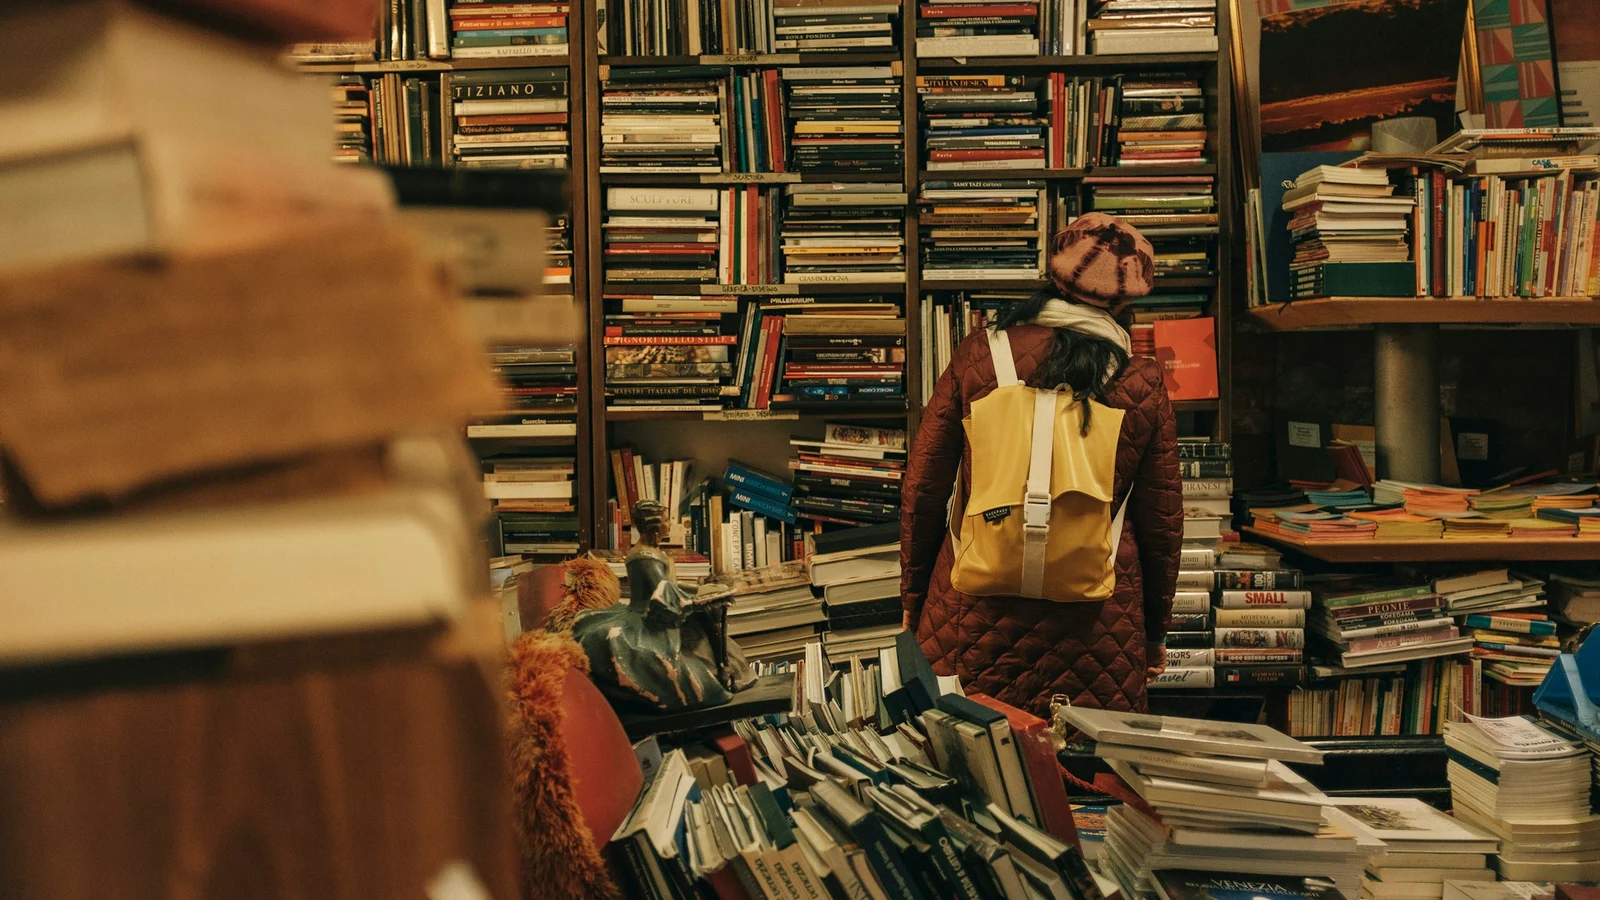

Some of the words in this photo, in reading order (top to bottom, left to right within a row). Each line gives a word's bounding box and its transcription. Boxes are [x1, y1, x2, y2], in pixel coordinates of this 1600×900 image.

[456, 84, 534, 97] TIZIANO
[630, 195, 694, 204] SCULPTURE
[729, 472, 745, 483] MINI
[745, 478, 765, 490] WATCH
[1183, 482, 1220, 491] PIRANESI
[735, 492, 751, 504] MINI
[751, 499, 771, 510] WATCH
[732, 520, 740, 554] CONCEPT
[1254, 574, 1263, 588] 100
[1245, 592, 1287, 604] SMALL
[1368, 602, 1410, 614] PEONIE
[1380, 611, 1415, 620] KOKEDAMA
[1383, 617, 1418, 626] KOKEDAMA
[1376, 639, 1398, 649] Arte
[1166, 652, 1191, 660] RIORS
[1156, 670, 1189, 683] ravel
[754, 858, 780, 897] venezia
[774, 862, 800, 899] venezia
[792, 862, 818, 899] venezia
[1210, 878, 1287, 892] VENEZIA
